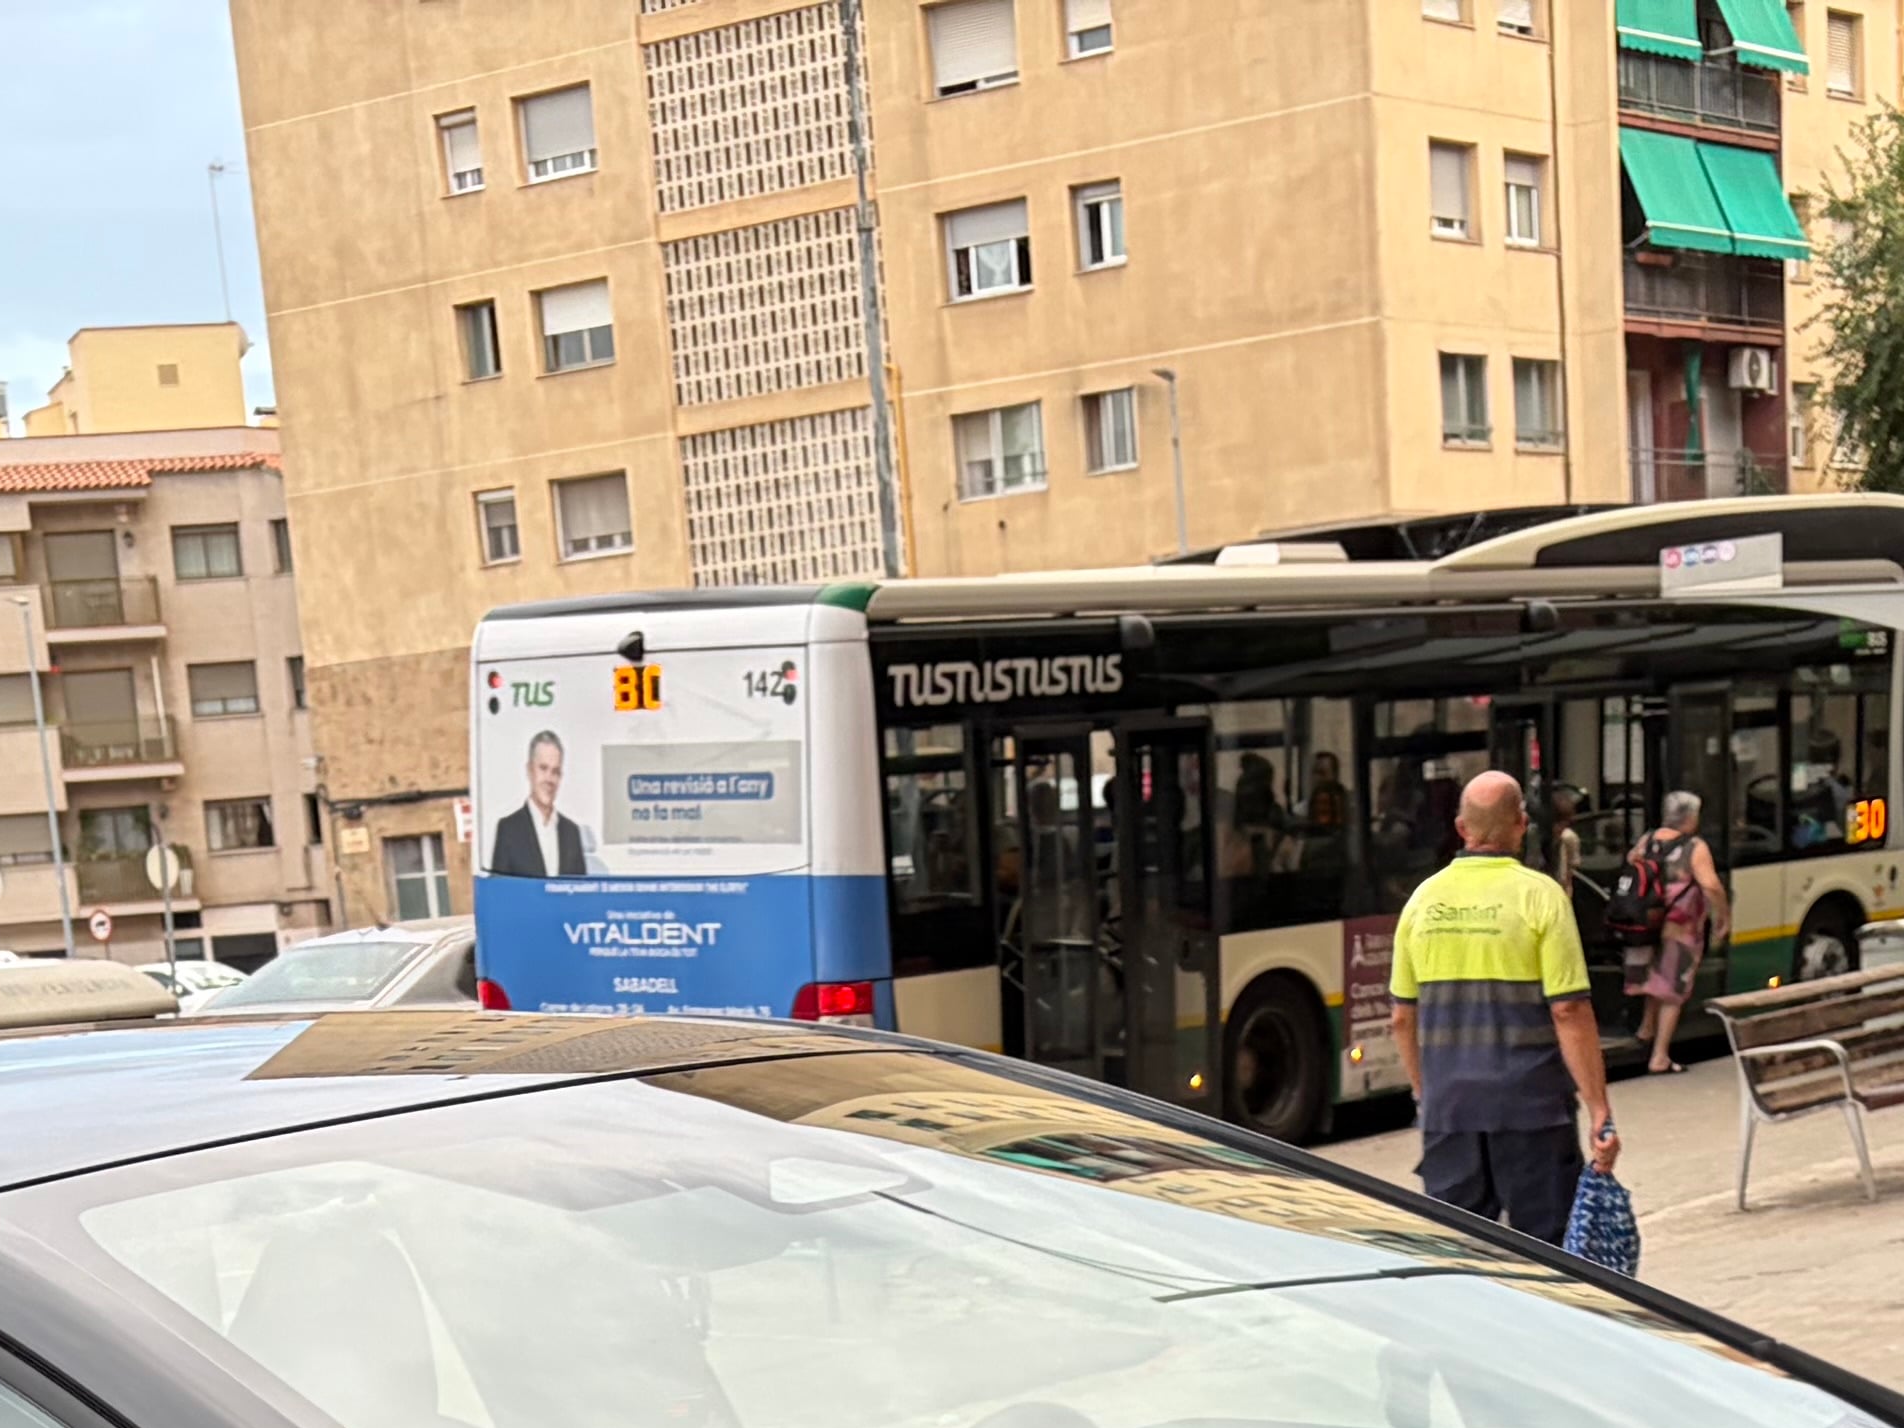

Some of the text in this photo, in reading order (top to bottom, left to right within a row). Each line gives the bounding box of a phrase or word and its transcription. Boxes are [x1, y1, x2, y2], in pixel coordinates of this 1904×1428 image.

[511, 681, 555, 707] TUS
[742, 669, 786, 698] 142
[631, 778, 662, 795] Una
[663, 775, 714, 794] revisió
[716, 780, 728, 793] a
[631, 806, 651, 821] no
[653, 803, 669, 821] fa
[563, 922, 722, 945] VITALDENT
[613, 977, 679, 993] SABADELL
